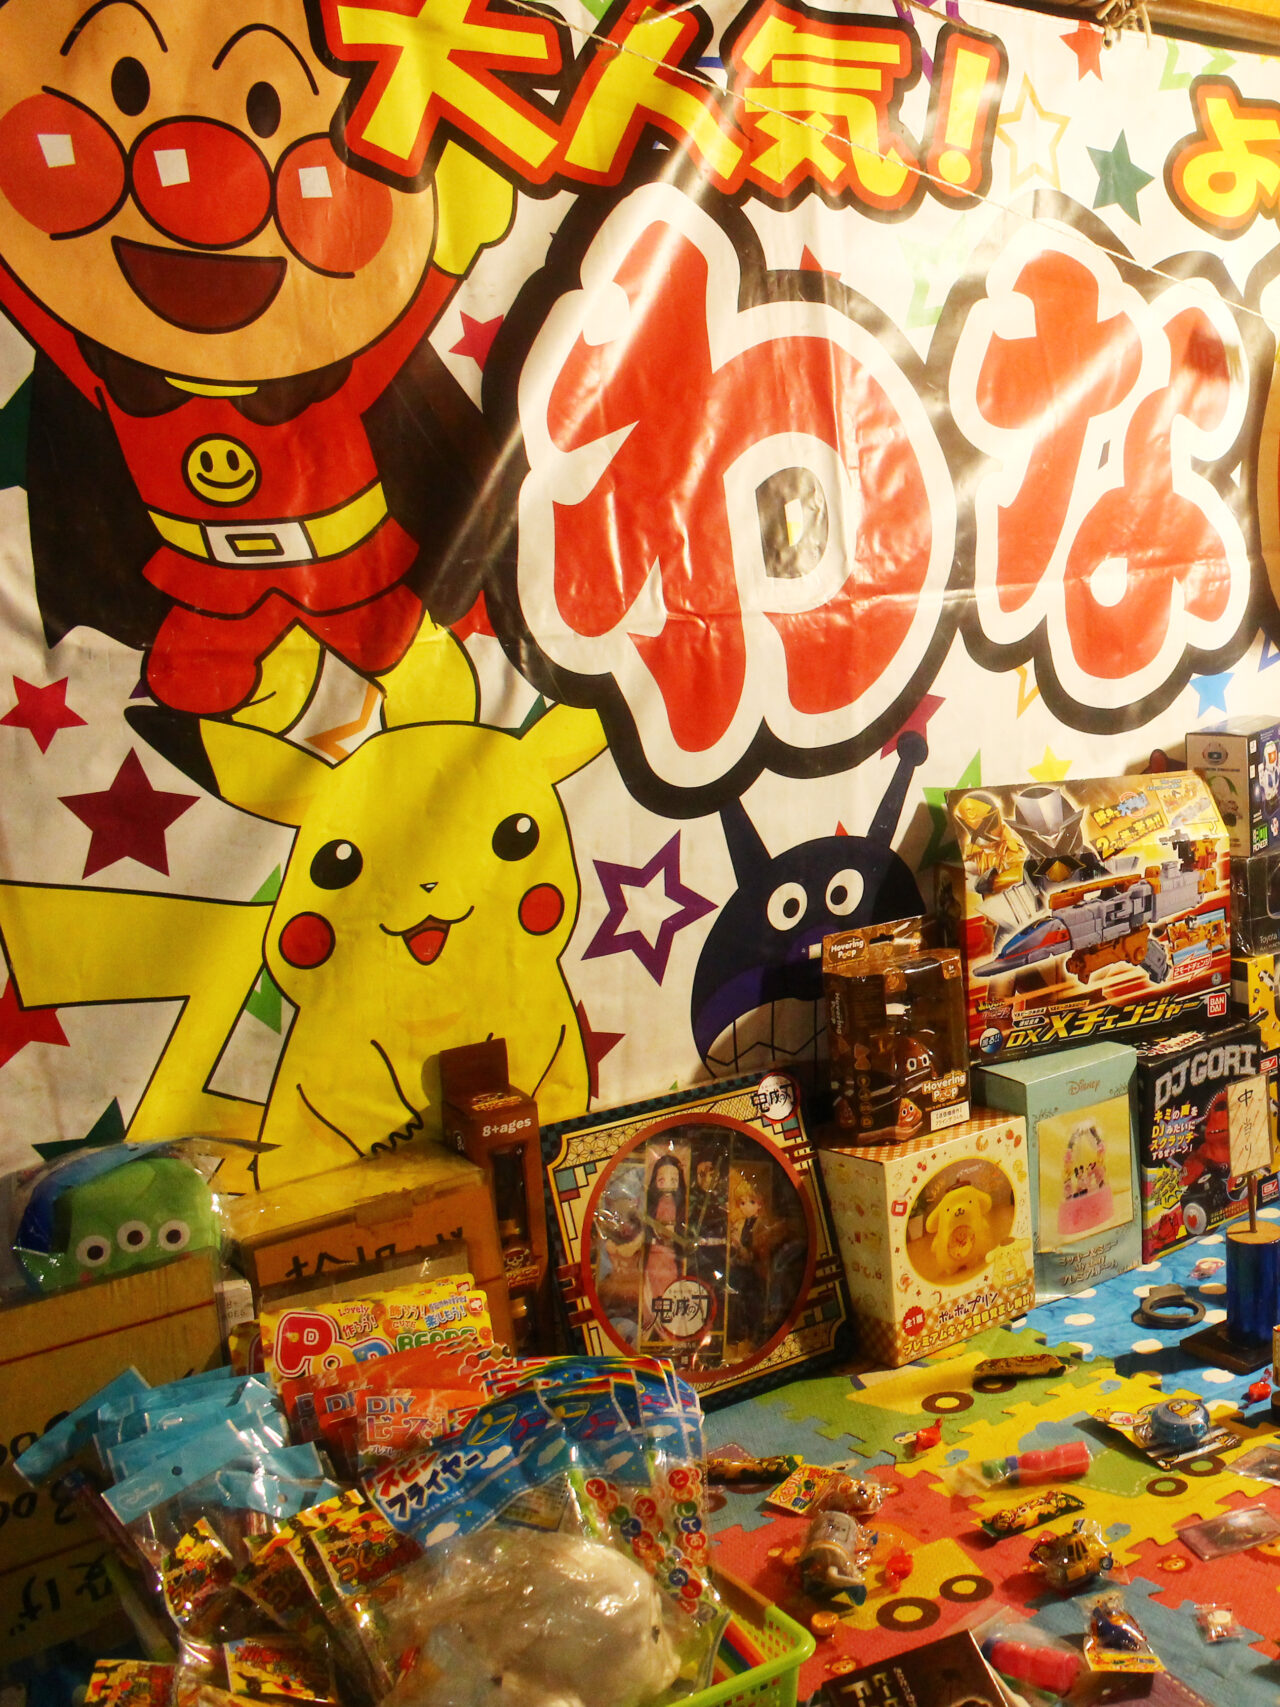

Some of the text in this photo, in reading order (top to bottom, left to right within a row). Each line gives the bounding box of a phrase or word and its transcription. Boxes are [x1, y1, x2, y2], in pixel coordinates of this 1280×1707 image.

[325, 0, 1003, 211] 大人気!
[1209, 995, 1225, 1007] BAN
[1209, 1003, 1223, 1014] DAI
[923, 1072, 966, 1093] Hovering
[1154, 1056, 1190, 1110] DJ
[1189, 1044, 1259, 1086] GORI
[1150, 1132, 1194, 1151] スクラッチ
[337, 1304, 370, 1318] Lovely
[938, 1291, 999, 1324] ポムポムプリン
[365, 1395, 416, 1415] DIY
[385, 1450, 486, 1521] フライヤー
